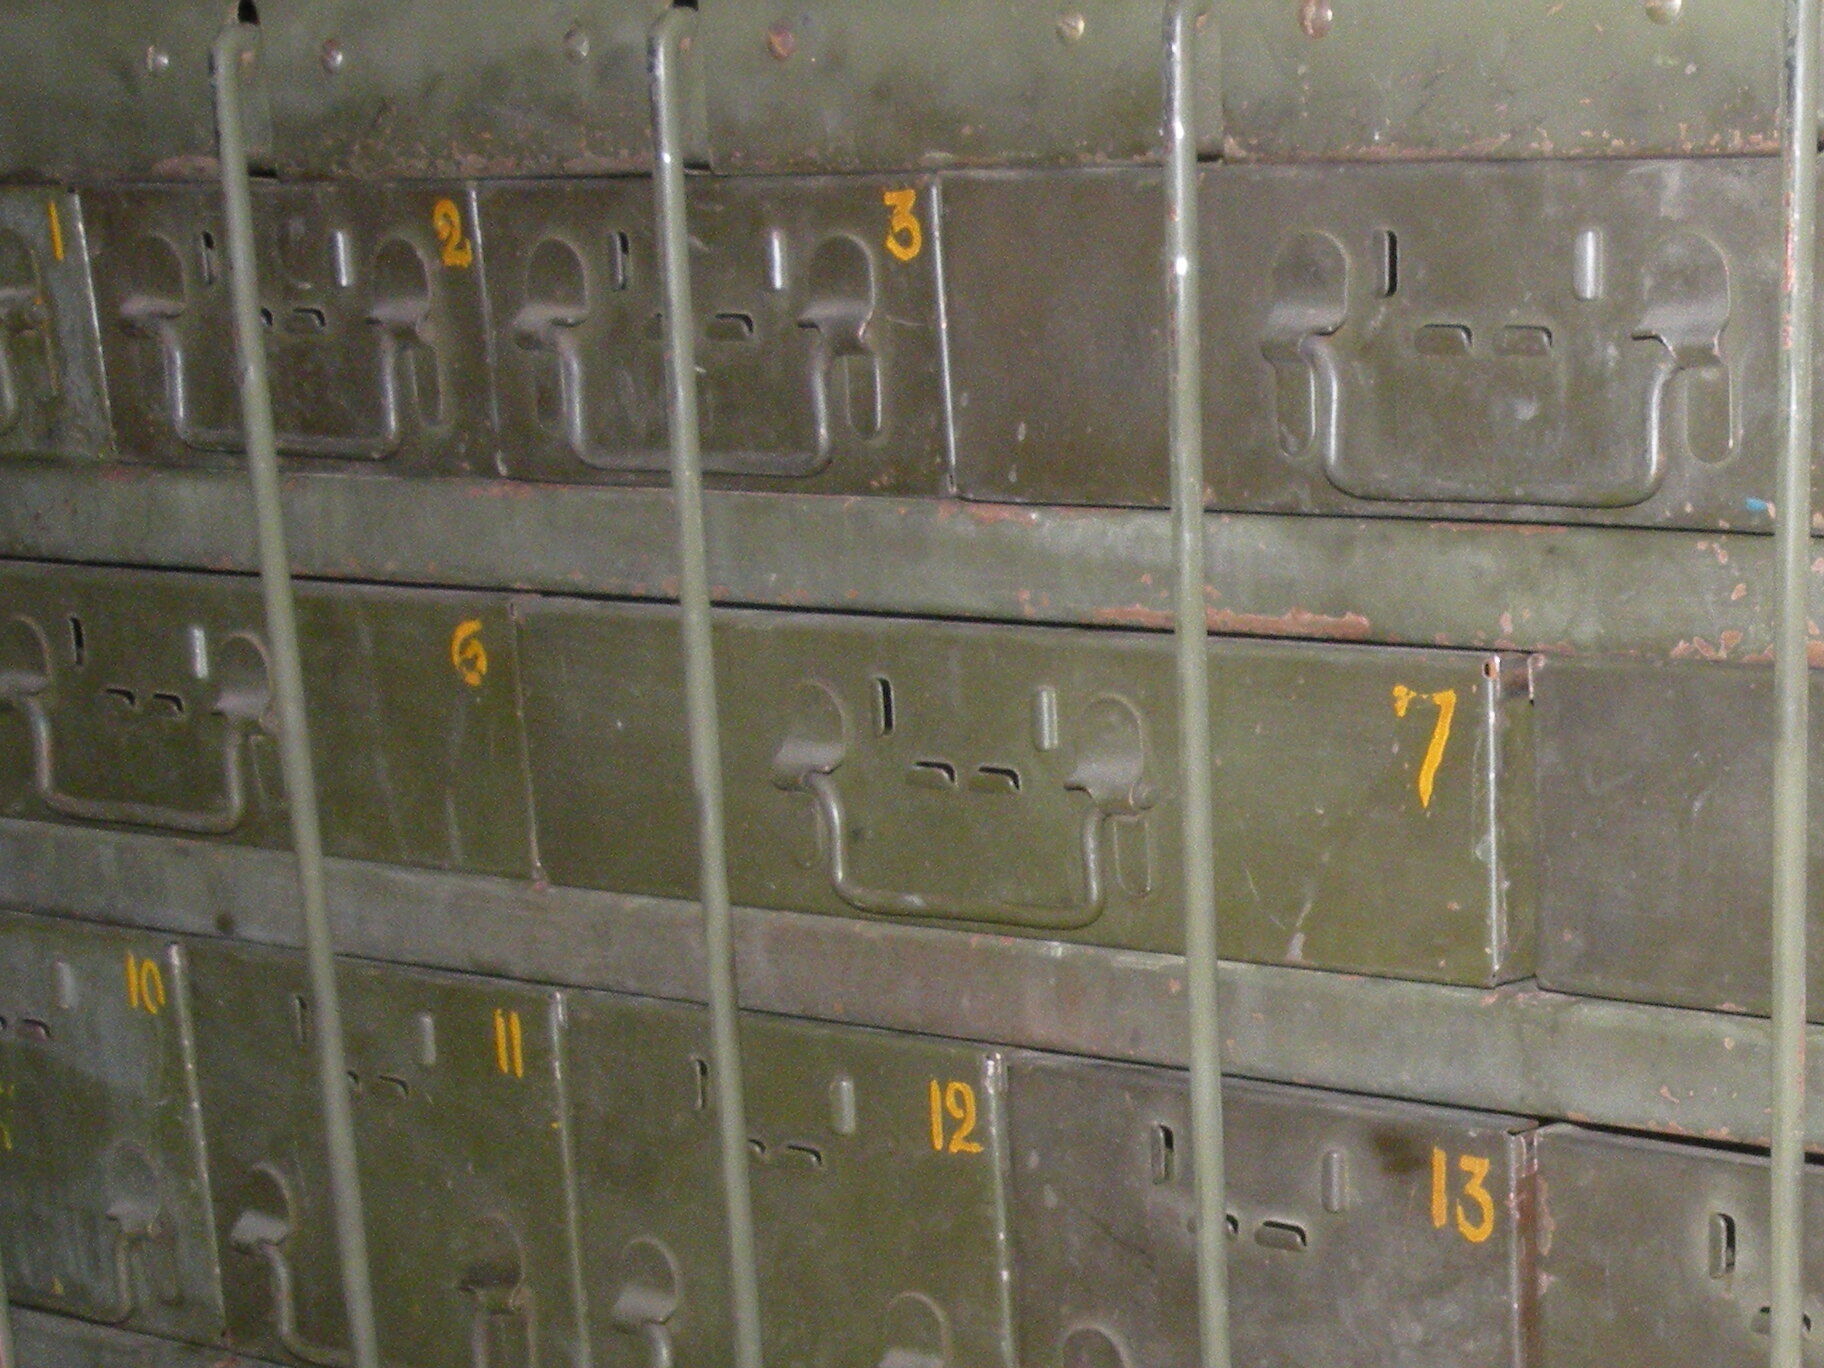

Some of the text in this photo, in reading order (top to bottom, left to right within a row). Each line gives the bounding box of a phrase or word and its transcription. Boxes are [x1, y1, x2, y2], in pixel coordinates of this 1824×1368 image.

[48, 202, 64, 261] 1
[433, 199, 473, 268] 2
[883, 187, 924, 262] 3
[450, 617, 489, 688] 6
[1389, 683, 1459, 809] 7
[126, 953, 166, 1015] 10
[494, 1008, 525, 1078] 11
[929, 1078, 984, 1156] 12
[1428, 1146, 1496, 1246] 13
